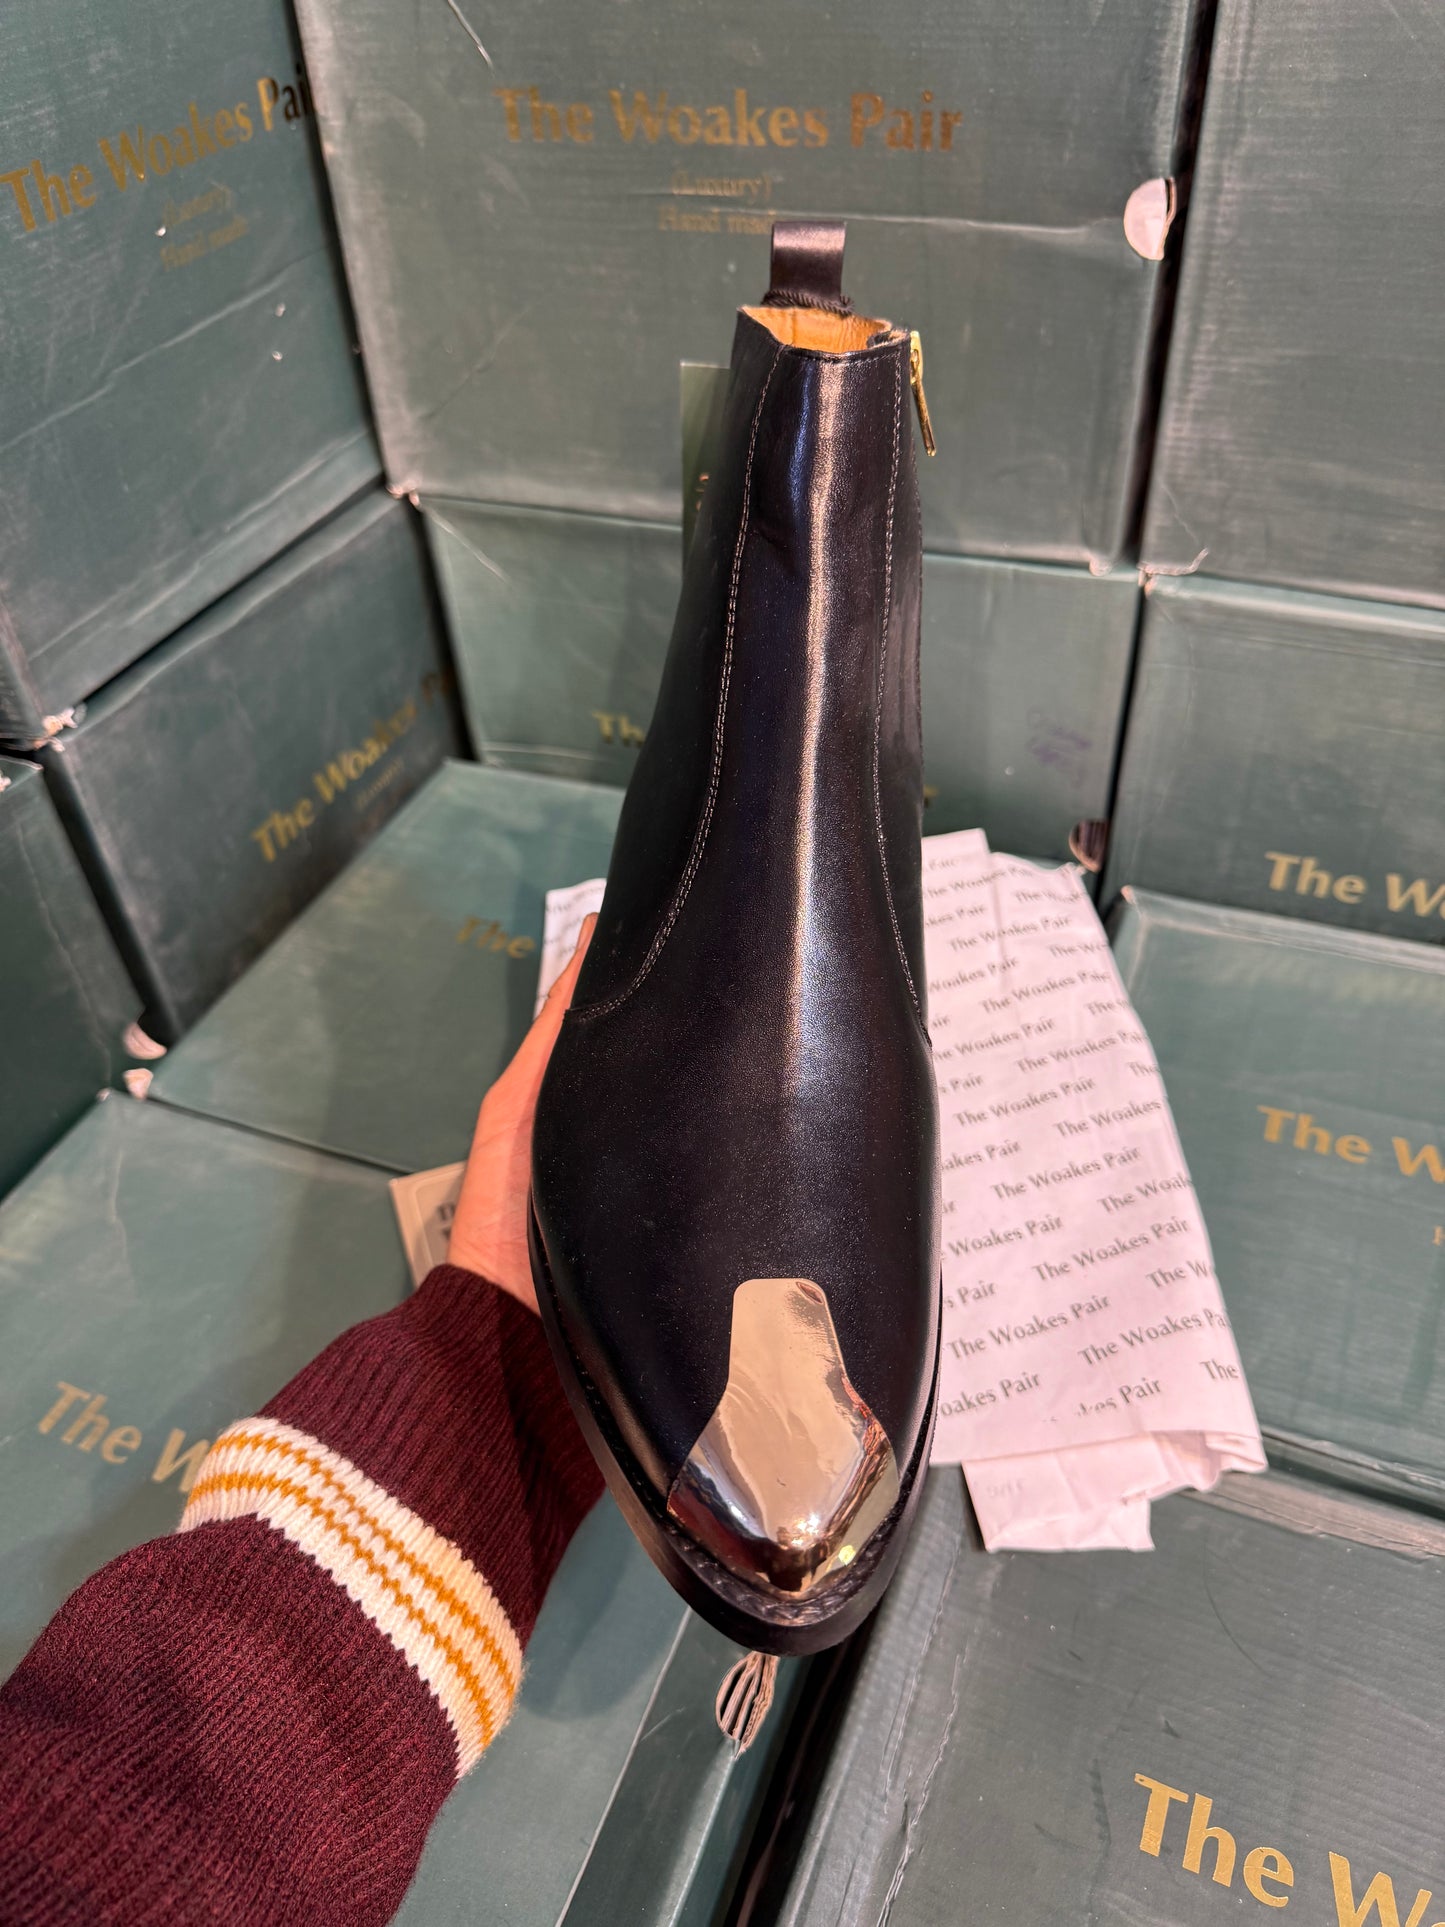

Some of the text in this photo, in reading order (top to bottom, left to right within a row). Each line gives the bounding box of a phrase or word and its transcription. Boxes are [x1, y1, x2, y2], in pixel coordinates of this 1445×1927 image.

[493, 86, 964, 151] The Woakes Pair
[0, 159, 96, 233] The
[99, 102, 252, 192] Woakes
[253, 798, 315, 862] The
[1264, 851, 1367, 904] The
[979, 923, 1039, 943] Woakes
[1040, 915, 1070, 930] Pair
[986, 957, 1018, 975] Pair
[980, 998, 1010, 1013] The
[1011, 976, 1076, 1001] Woakes
[953, 1031, 1020, 1057] Woakes
[1020, 1017, 1054, 1038] Pair
[1015, 1056, 1048, 1073] The
[1048, 1037, 1117, 1062] Woakes
[949, 1073, 984, 1092] Pair
[952, 1076, 1097, 1127] The Woakes Pair
[1051, 1100, 1162, 1138] The Woakes
[1257, 1104, 1371, 1164] The
[984, 1139, 1022, 1160] Pair
[989, 1146, 1142, 1200] The Woakes Pair
[1096, 1194, 1136, 1214] The
[948, 1228, 1023, 1257] Woakes
[1025, 1213, 1063, 1236] Pair
[1031, 1215, 1188, 1281] The Woakes Pair
[957, 1280, 997, 1305] Pair
[1145, 1267, 1187, 1288] The
[946, 1295, 1110, 1359] The Woakes Pair
[1077, 1340, 1119, 1366] The
[1119, 1313, 1202, 1347] Woakes
[999, 1371, 1040, 1398] Pair
[1199, 1358, 1239, 1381] The
[1118, 1377, 1161, 1404] Pair
[37, 1380, 143, 1464] The
[1134, 1773, 1445, 1927] The W
